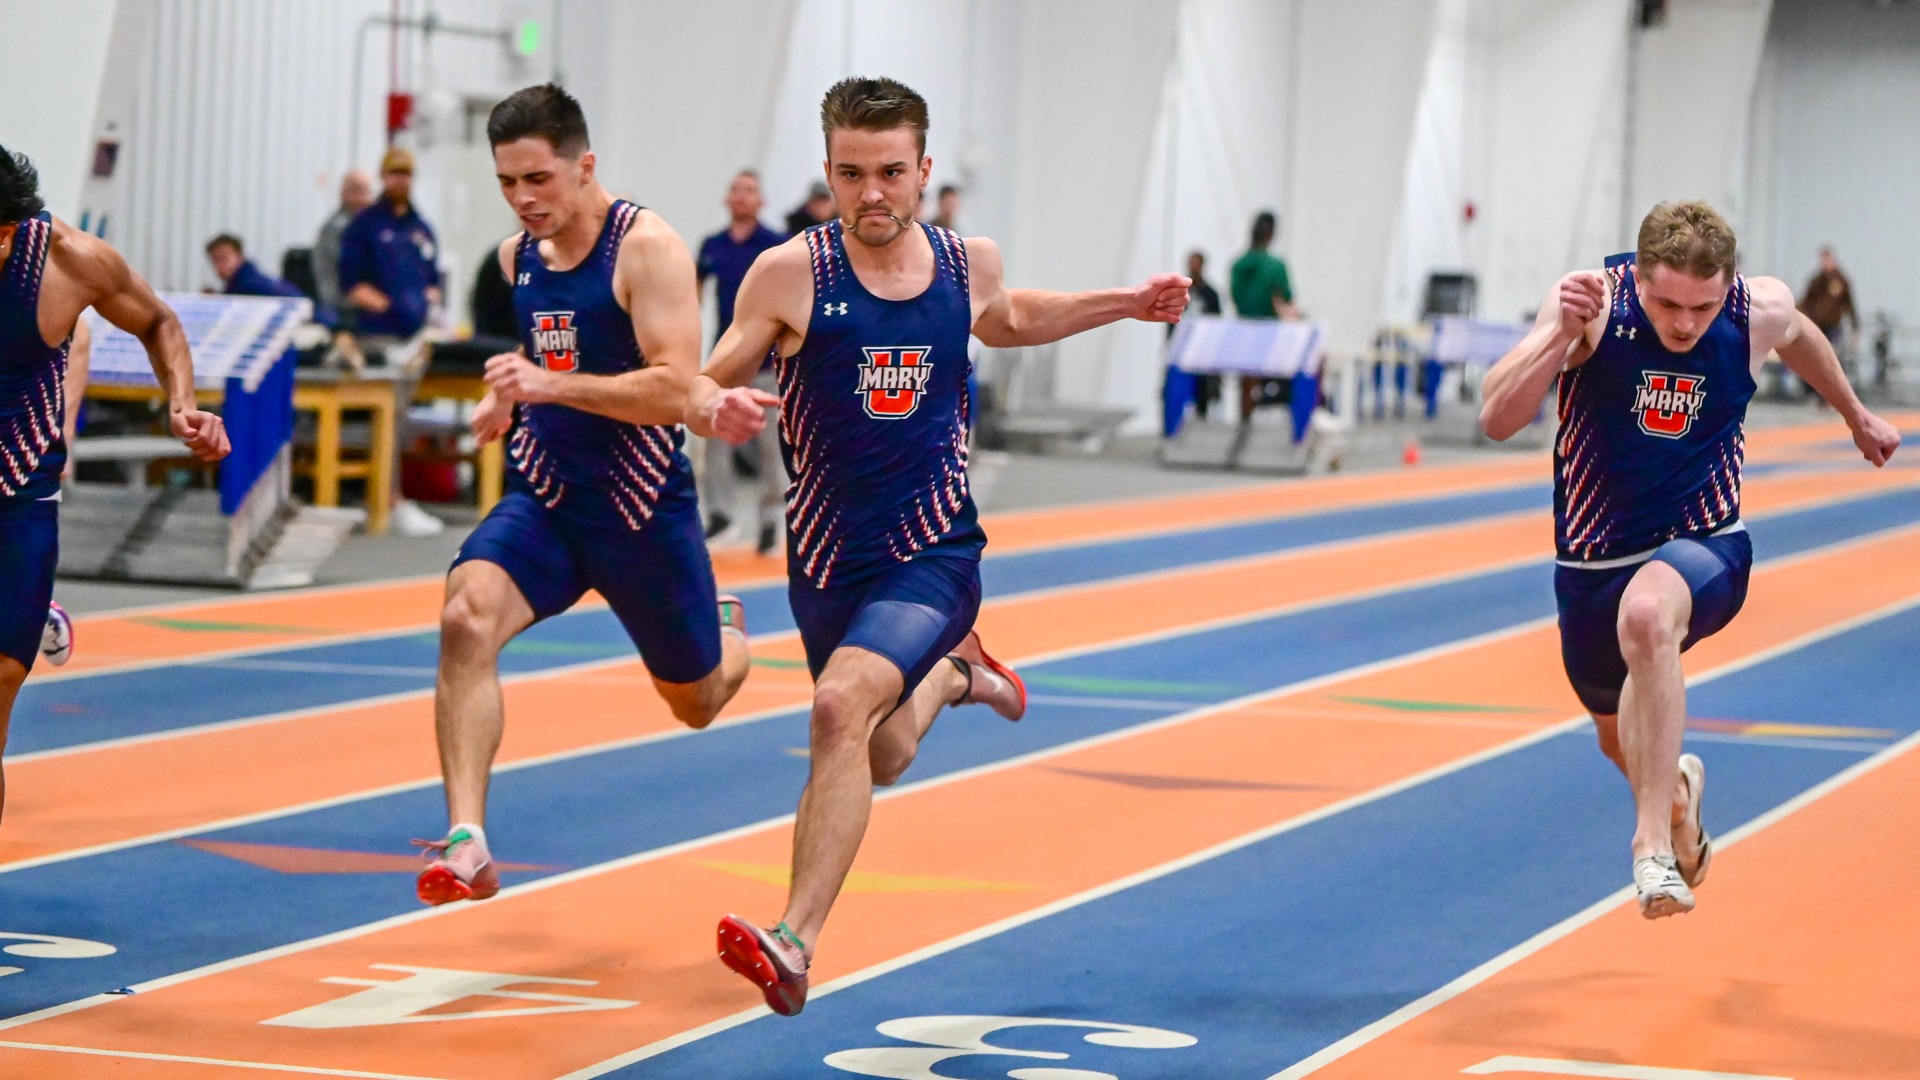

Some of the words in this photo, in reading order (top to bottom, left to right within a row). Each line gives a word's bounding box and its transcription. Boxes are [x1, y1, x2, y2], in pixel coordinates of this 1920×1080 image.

[861, 366, 928, 390] MARY
[861, 347, 932, 420] U
[1638, 388, 1700, 415] MARY
[1638, 370, 1706, 440] U
[258, 963, 640, 1029] 4
